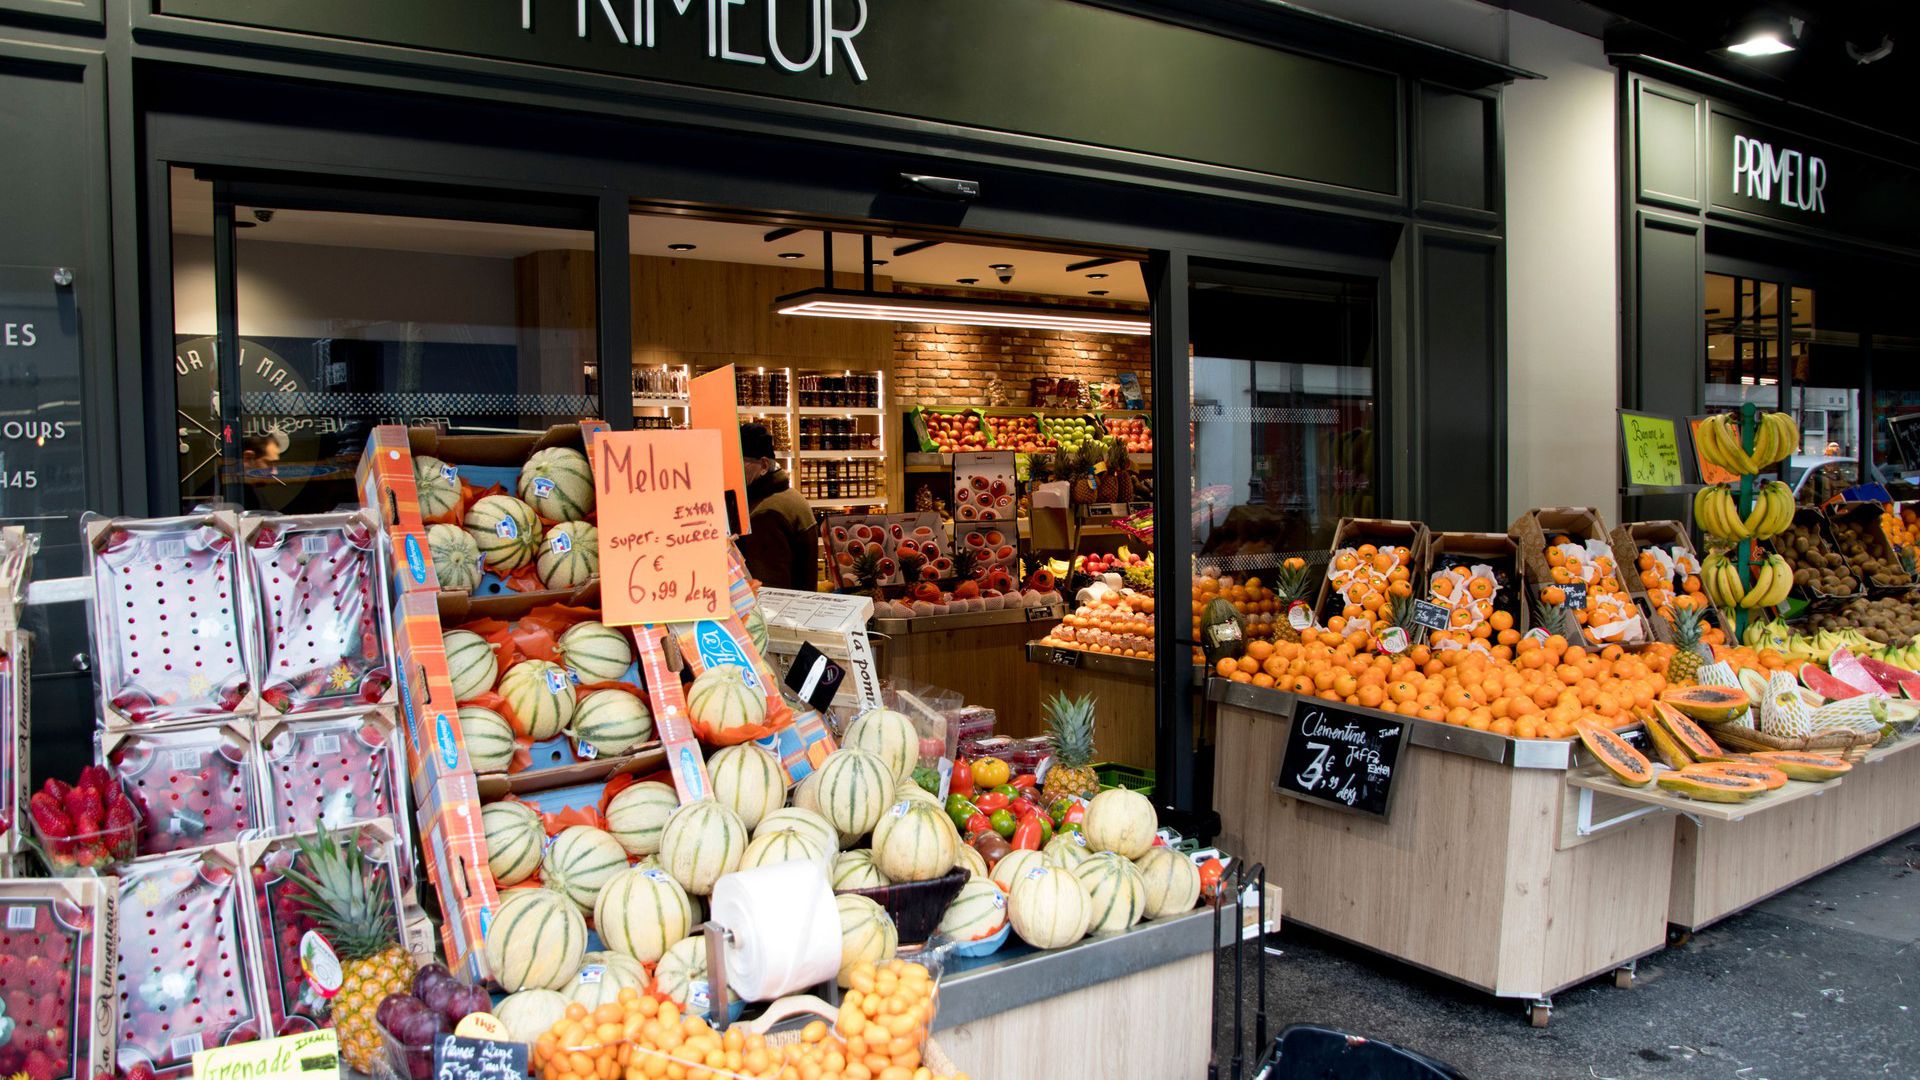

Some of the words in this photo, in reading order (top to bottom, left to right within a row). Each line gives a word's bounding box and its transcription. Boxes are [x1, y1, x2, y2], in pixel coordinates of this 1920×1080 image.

[522, 0, 868, 81] MEUR
[1733, 134, 1826, 213] PRIMEUR
[851, 629, 865, 653] la
[295, 1032, 336, 1051] ISRAEL
